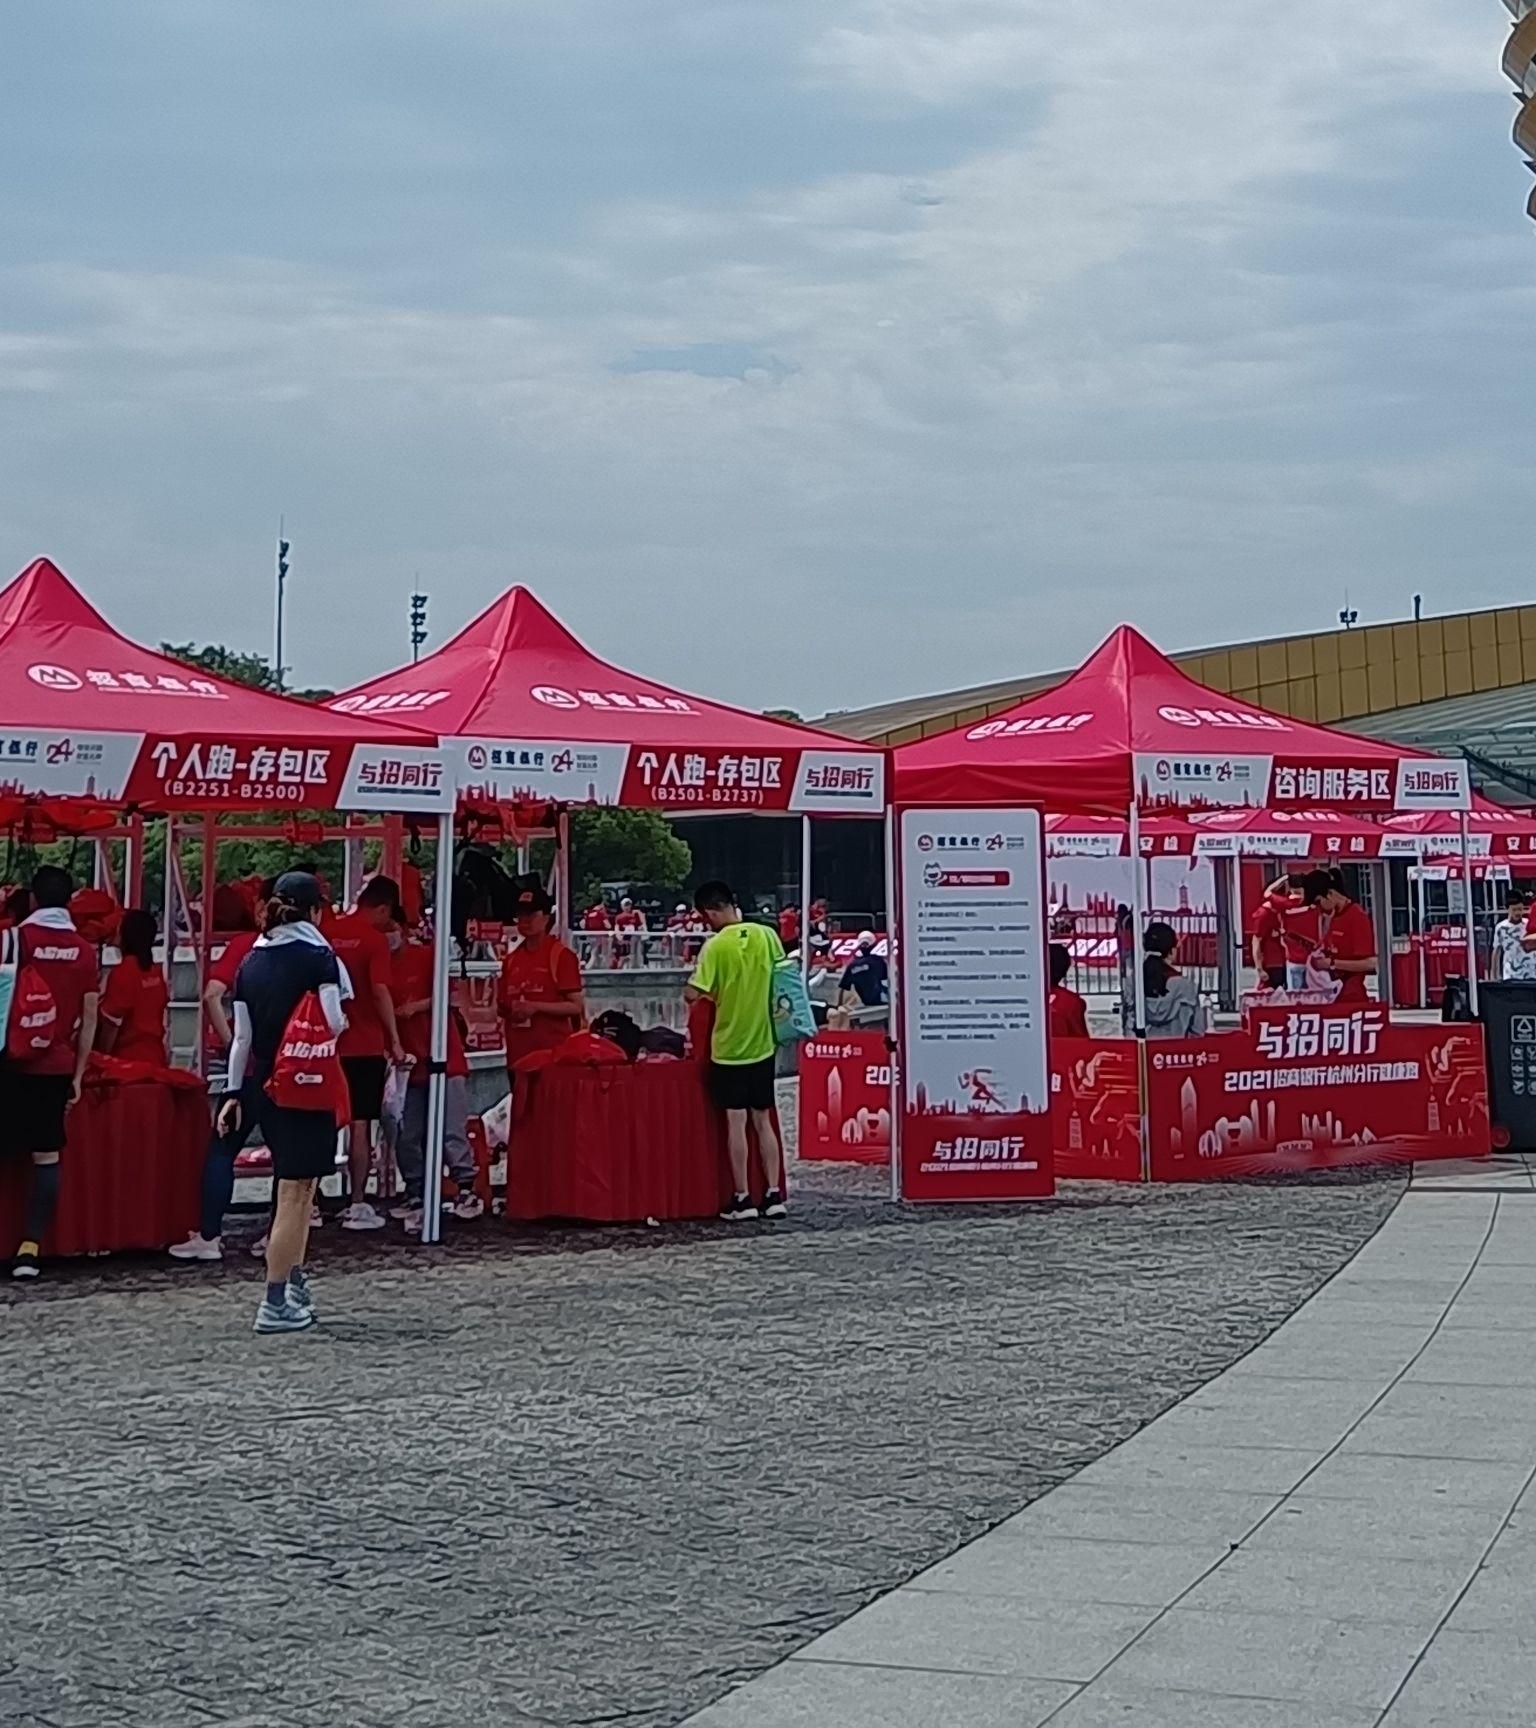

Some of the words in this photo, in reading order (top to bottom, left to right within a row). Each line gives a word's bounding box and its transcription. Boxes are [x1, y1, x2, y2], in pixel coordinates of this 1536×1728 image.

[150, 741, 331, 784] 个人跑-存包区
[358, 759, 444, 787] 与招同行
[635, 751, 784, 788] 个人跑-存包区
[805, 765, 875, 790] 与招同行
[163, 779, 306, 803] (B2251-B2500)
[1274, 766, 1392, 801] 咨询服务区
[1256, 1009, 1384, 1059] 与招同行
[932, 1135, 1026, 1161] 与招同行
